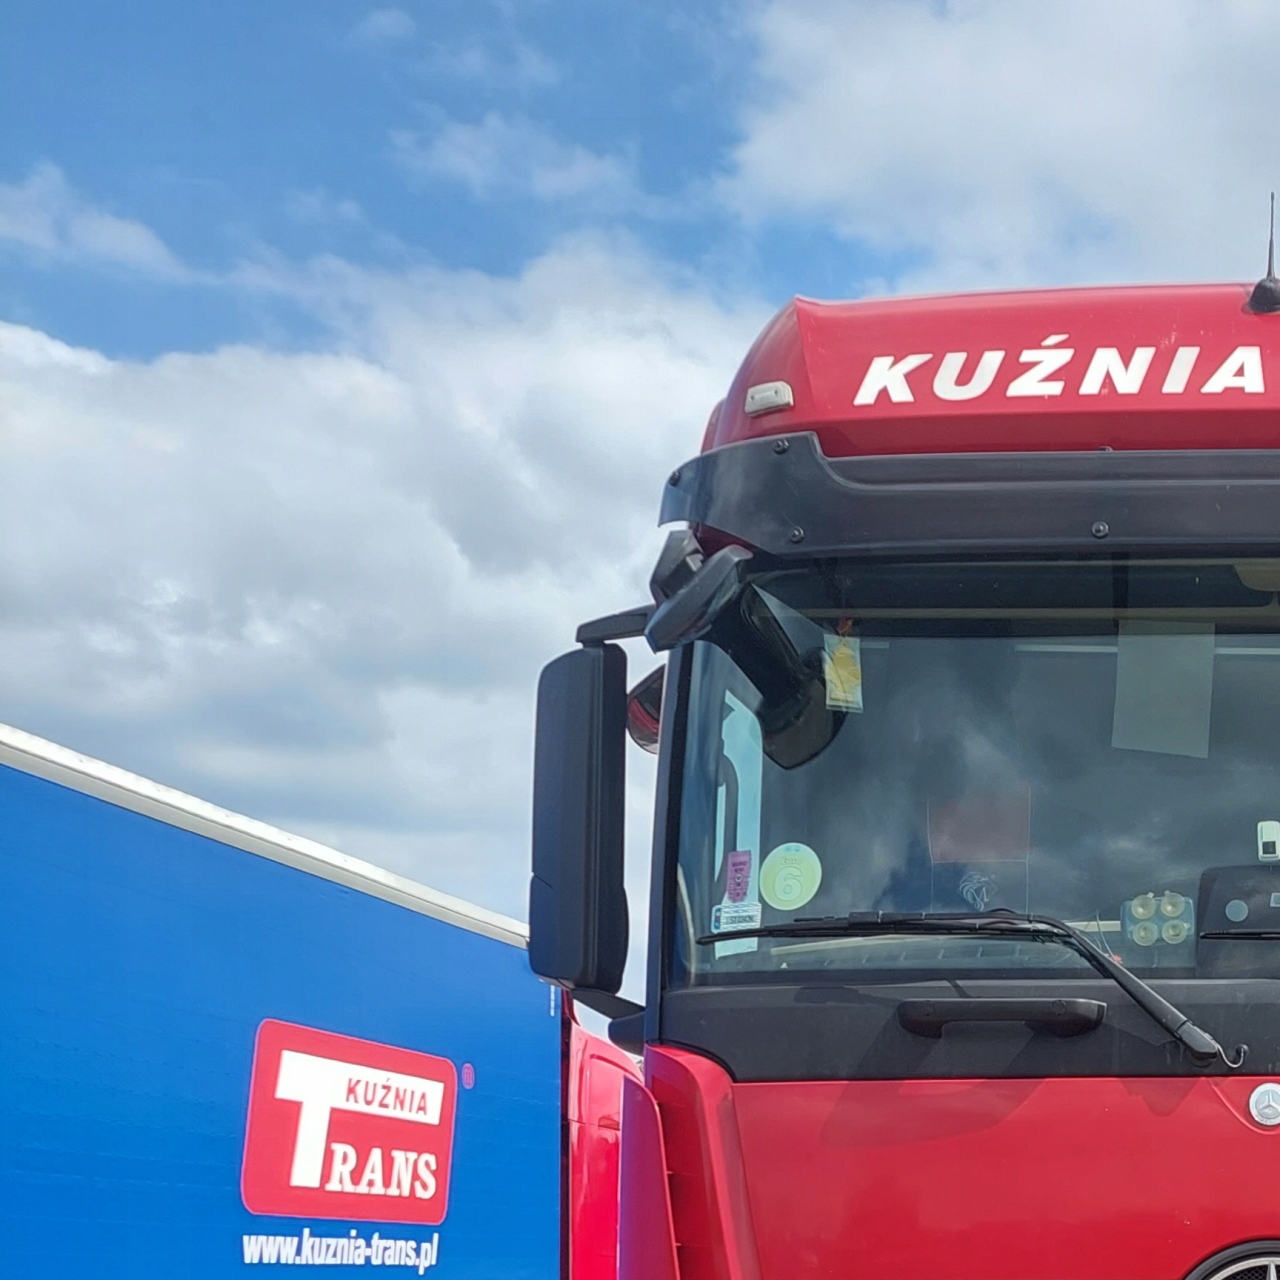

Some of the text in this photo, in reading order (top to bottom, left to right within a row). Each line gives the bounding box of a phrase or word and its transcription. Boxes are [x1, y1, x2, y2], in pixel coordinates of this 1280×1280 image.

[853, 333, 1265, 406] KUŹNIA
[774, 866, 803, 902] 6
[345, 1077, 429, 1117] KUŹNIA
[275, 1049, 445, 1200] TRANS
[242, 1227, 440, 1275] www.kuznia-trans.pl
